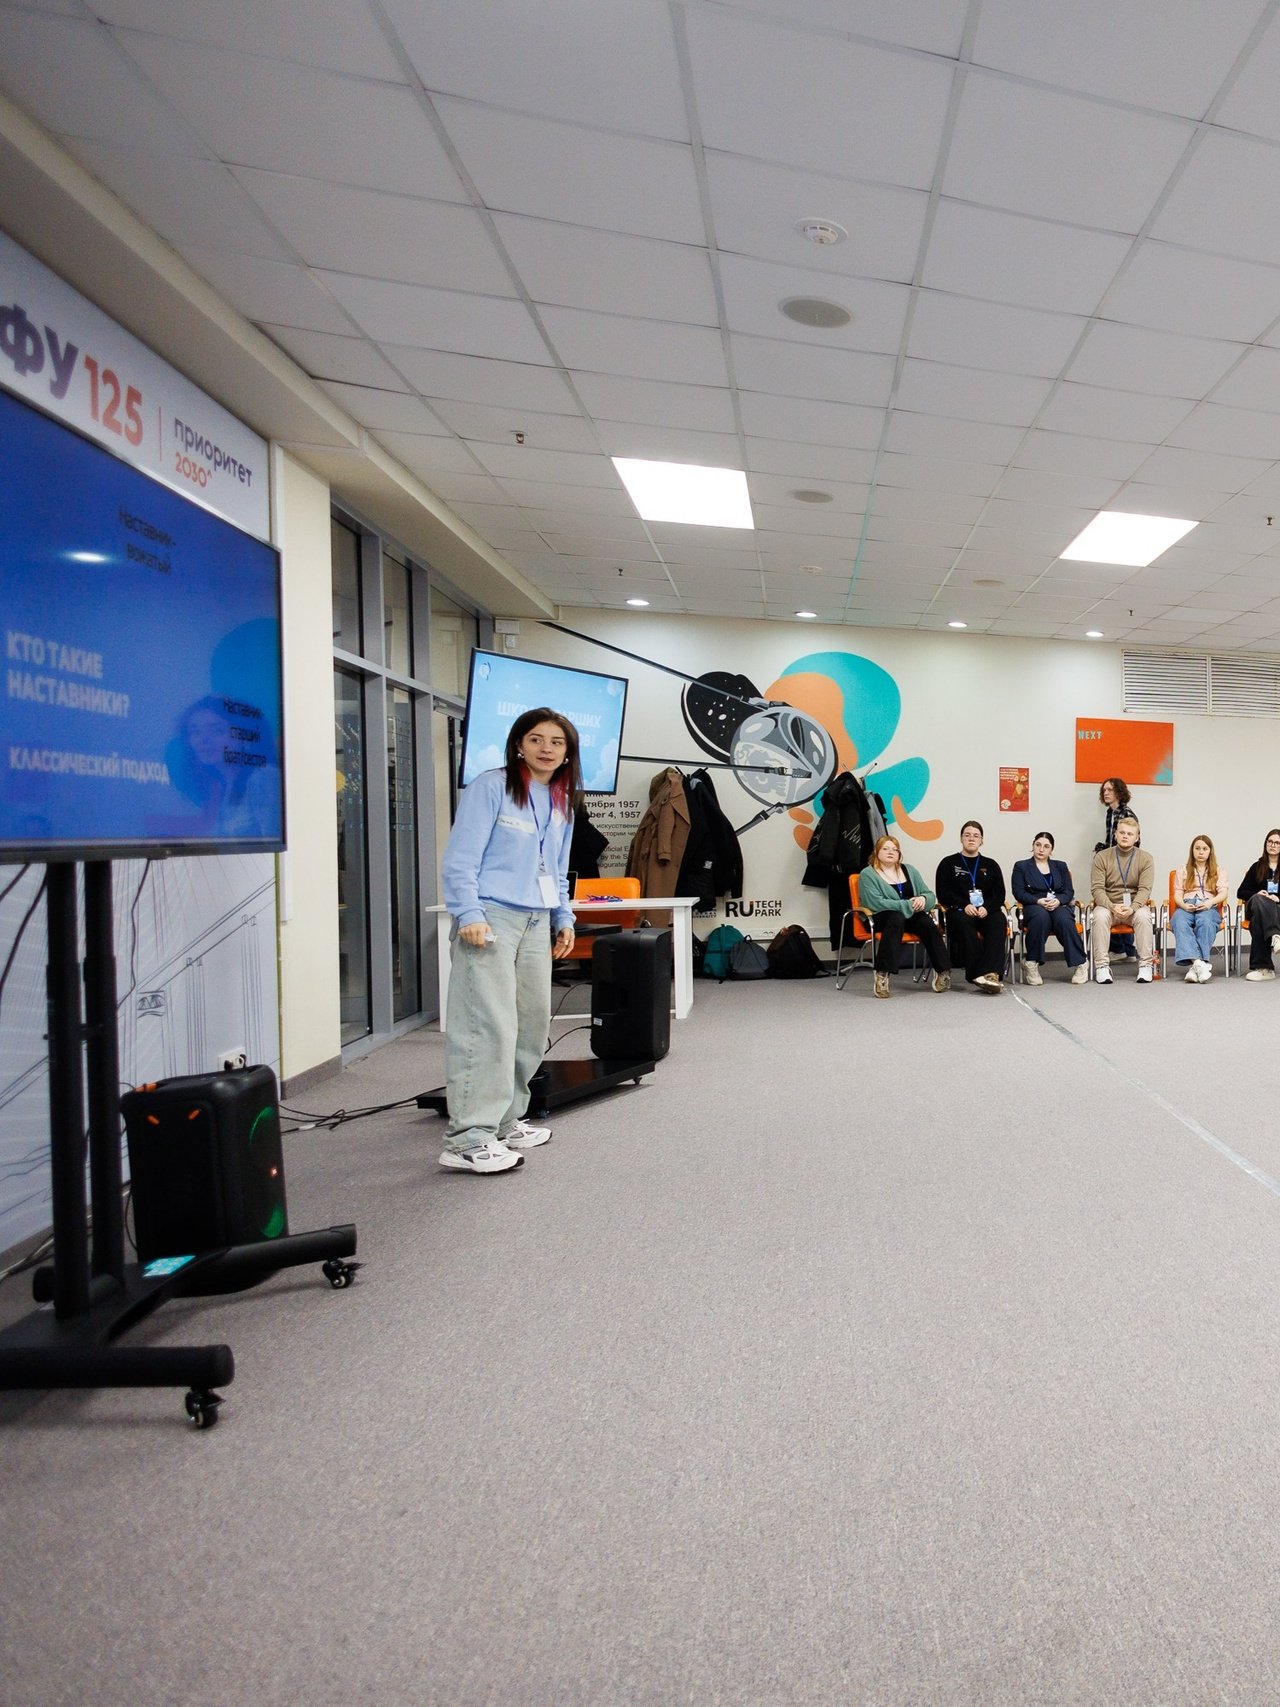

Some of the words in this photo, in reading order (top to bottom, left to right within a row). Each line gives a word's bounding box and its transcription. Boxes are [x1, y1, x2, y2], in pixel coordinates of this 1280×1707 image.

[84, 354, 143, 447] 125
[174, 417, 252, 488] приоритет
[7, 630, 45, 665] КТО
[47, 640, 103, 679] ТАКИЕ
[8, 668, 130, 718] НАСТАВНИКИ?
[1078, 731, 1102, 740] NEXT
[10, 746, 120, 779] КЛАССИЧЕСКИЙ
[122, 758, 170, 785] ПОДХОД
[608, 811, 617, 819] 4,
[725, 901, 754, 917] RU
